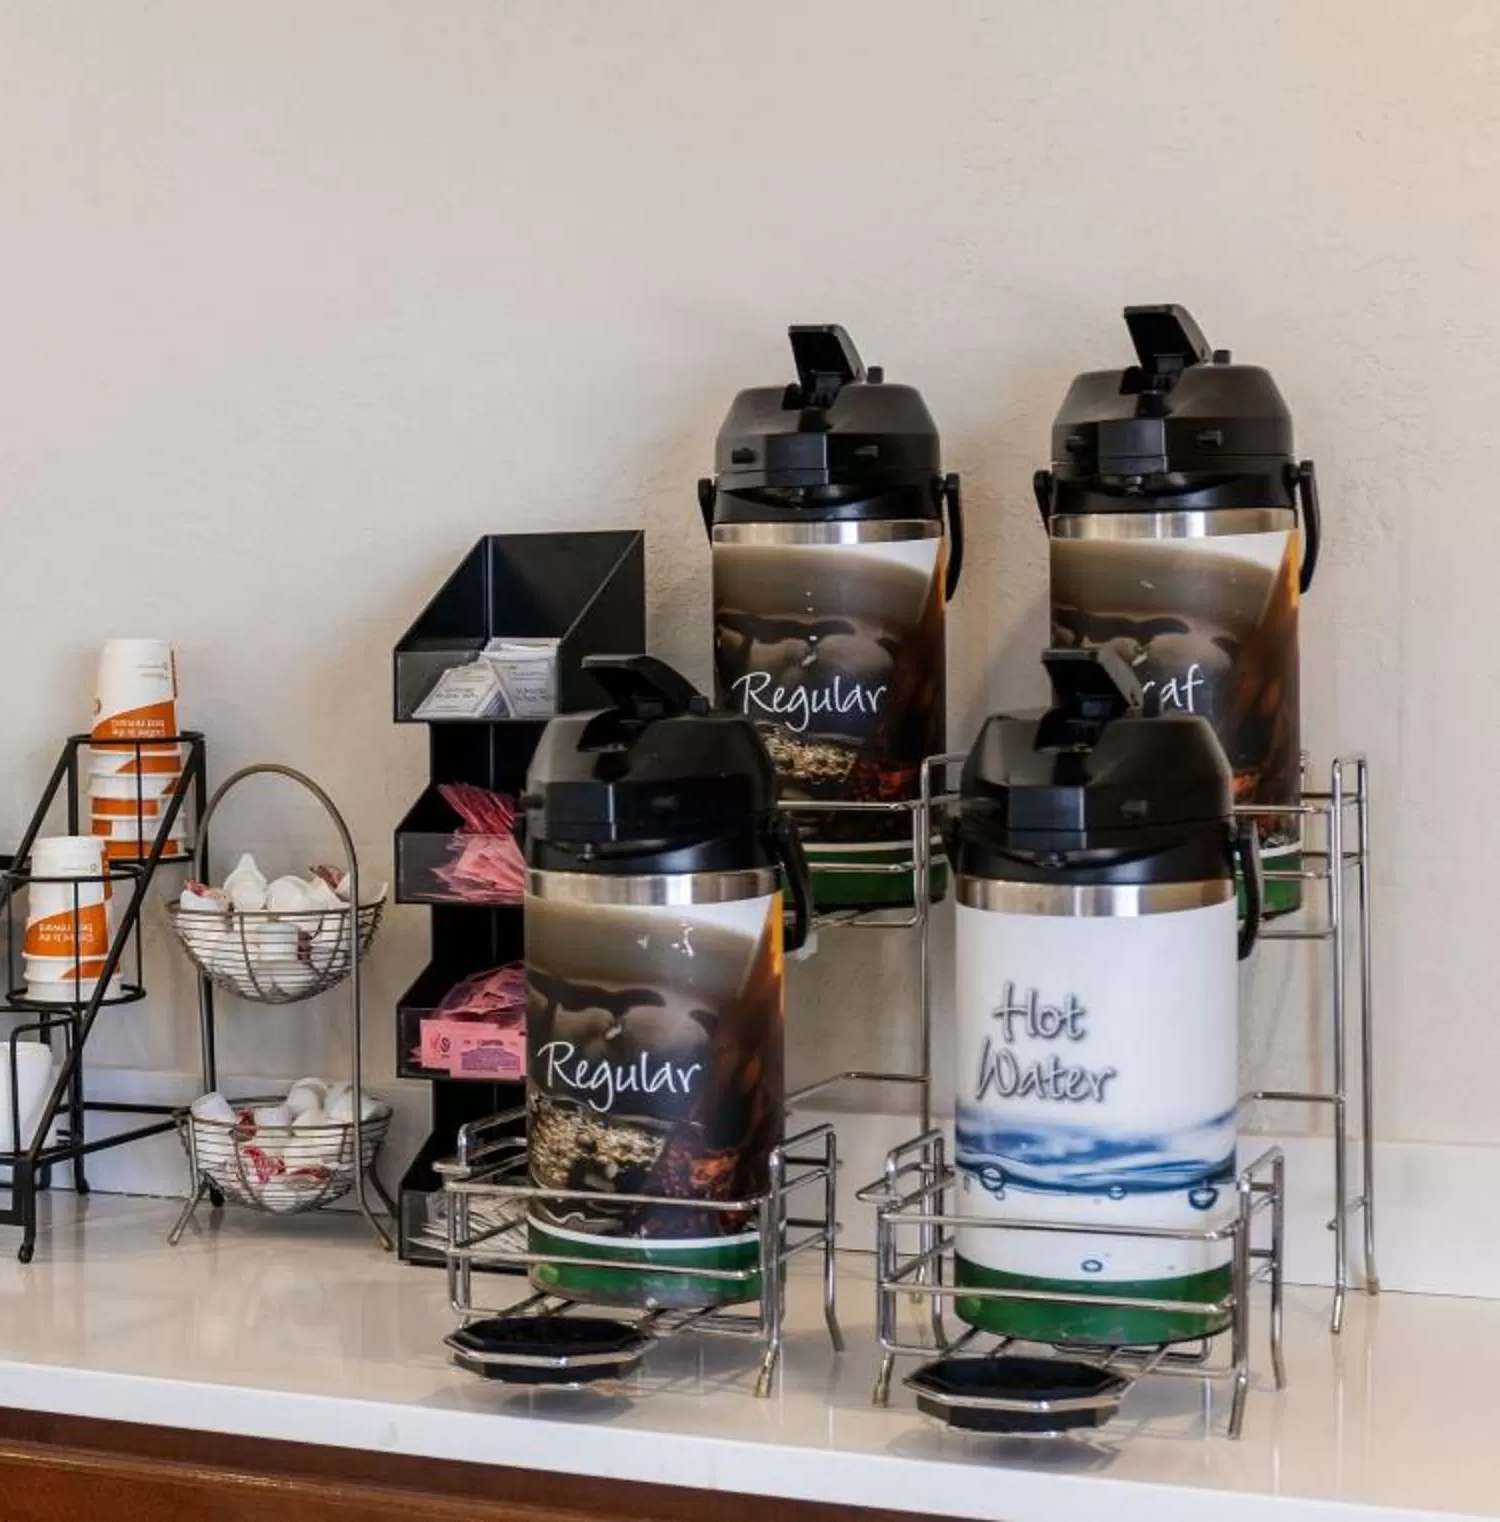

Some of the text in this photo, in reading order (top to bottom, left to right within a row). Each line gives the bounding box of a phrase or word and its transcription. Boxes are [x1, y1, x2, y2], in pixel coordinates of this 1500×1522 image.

[731, 671, 888, 733] Regular
[992, 980, 1088, 1043] Hot
[538, 1041, 702, 1112] Regular
[975, 1036, 1118, 1103] Water
